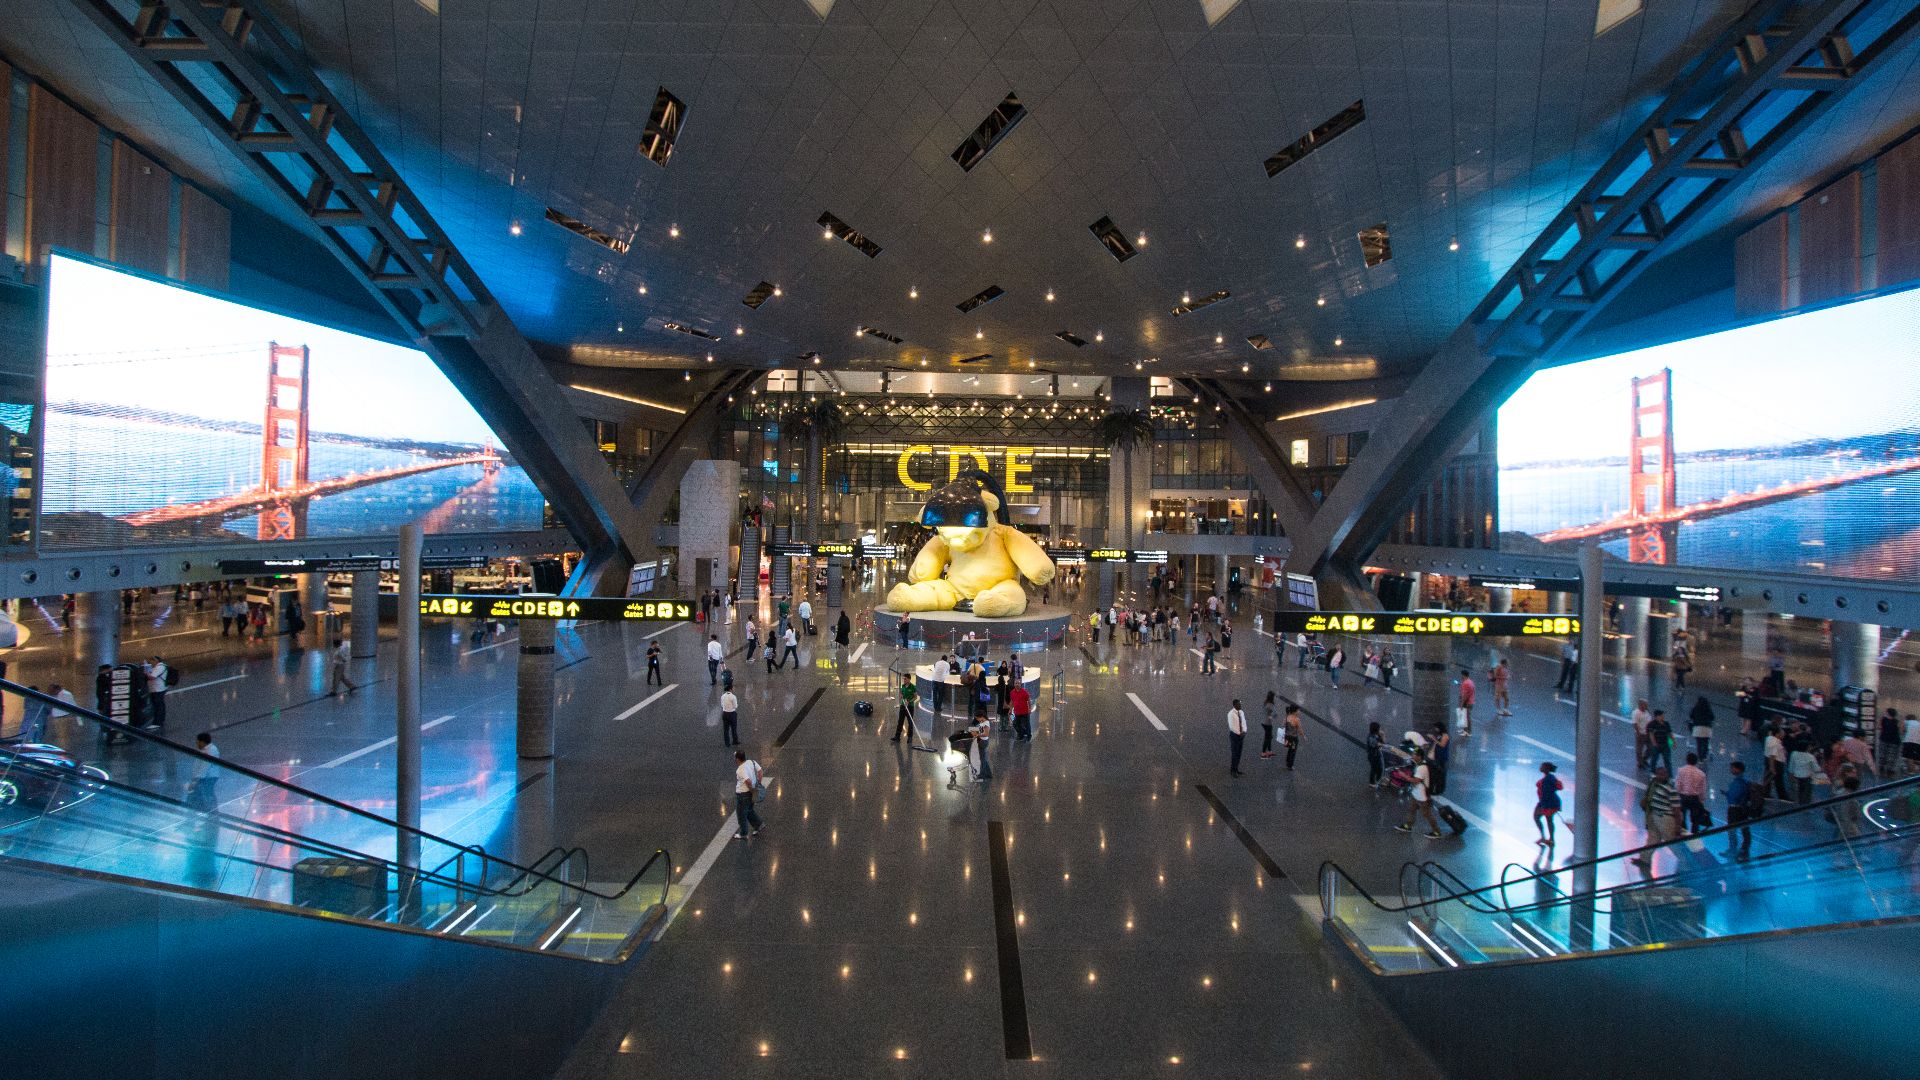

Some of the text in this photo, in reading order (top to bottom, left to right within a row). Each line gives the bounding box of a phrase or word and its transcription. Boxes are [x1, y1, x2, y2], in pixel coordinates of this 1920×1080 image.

[428, 599, 442, 613] A
[490, 608, 511, 616] Gates
[623, 603, 656, 618] Gates B
[1327, 616, 1342, 630] A
[1542, 618, 1554, 633] B
